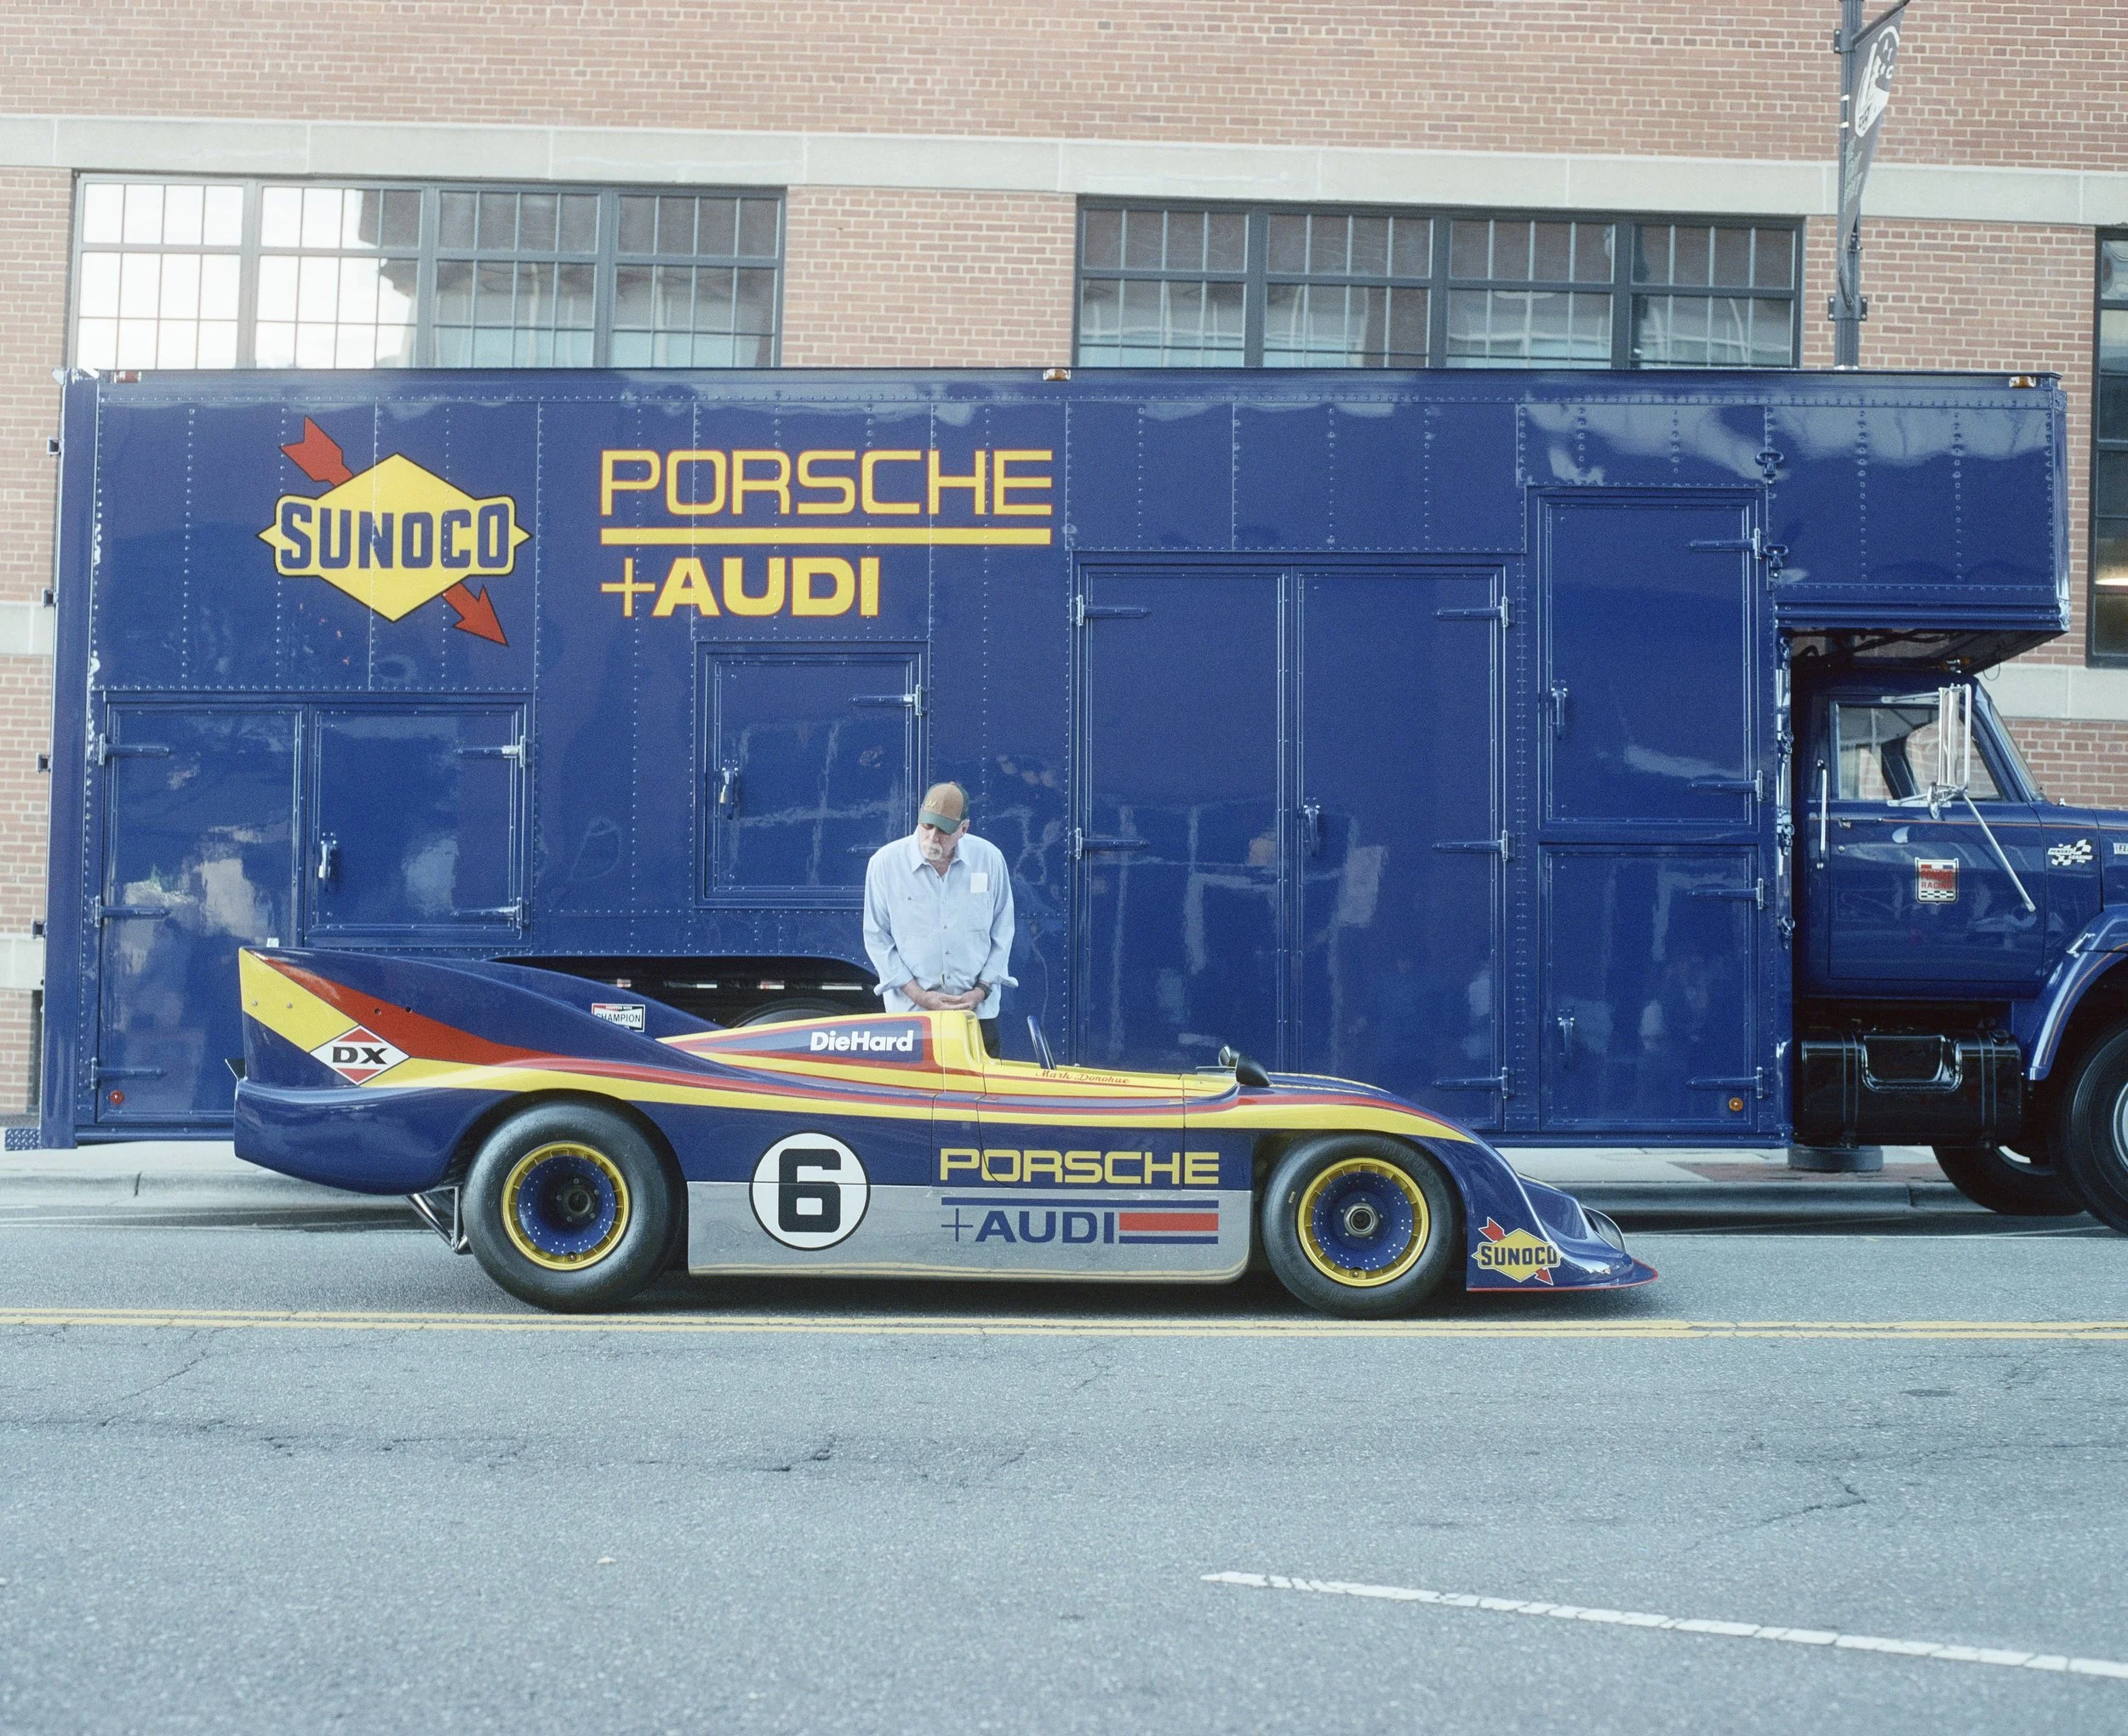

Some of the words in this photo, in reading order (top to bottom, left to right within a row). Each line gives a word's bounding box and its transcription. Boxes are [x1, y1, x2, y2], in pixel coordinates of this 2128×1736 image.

[601, 449, 1053, 516] PORSCHE
[280, 501, 510, 569] SUNOCO
[1920, 882, 1954, 890] RACING
[809, 1030, 914, 1052] DieHard
[331, 1046, 388, 1065] DX
[1036, 1069, 1071, 1080] Mark
[1074, 1072, 1130, 1084] Donohue
[940, 1148, 1220, 1185] PORSCHE
[778, 1148, 842, 1233] 6
[1480, 1244, 1558, 1266] SUNOCO
